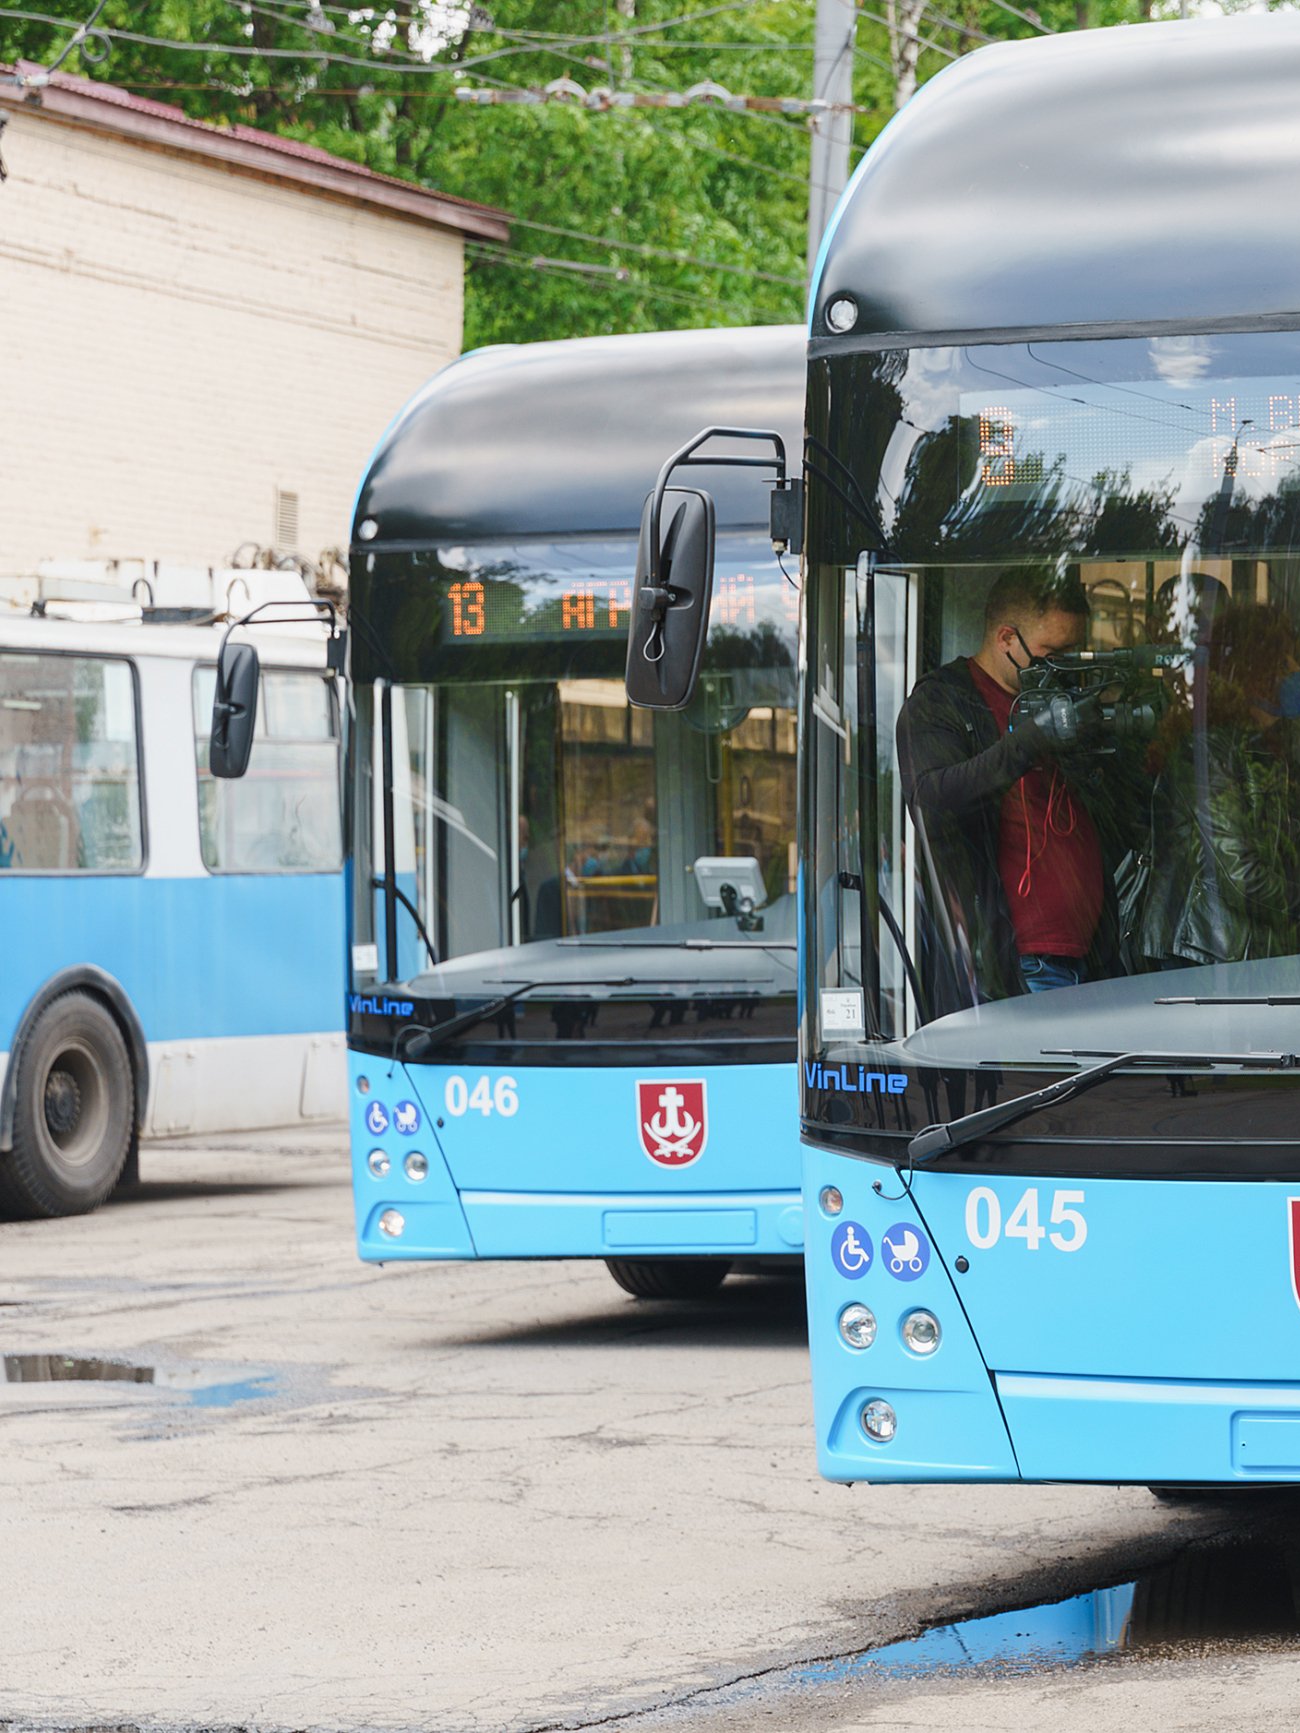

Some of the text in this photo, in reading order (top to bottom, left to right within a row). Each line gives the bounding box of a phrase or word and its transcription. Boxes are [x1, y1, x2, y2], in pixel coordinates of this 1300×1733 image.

[448, 581, 485, 636] 13
[347, 993, 415, 1017] VinLine
[444, 1075, 520, 1118] 046
[804, 1060, 909, 1095] VinLine
[964, 1185, 1089, 1253] 045
